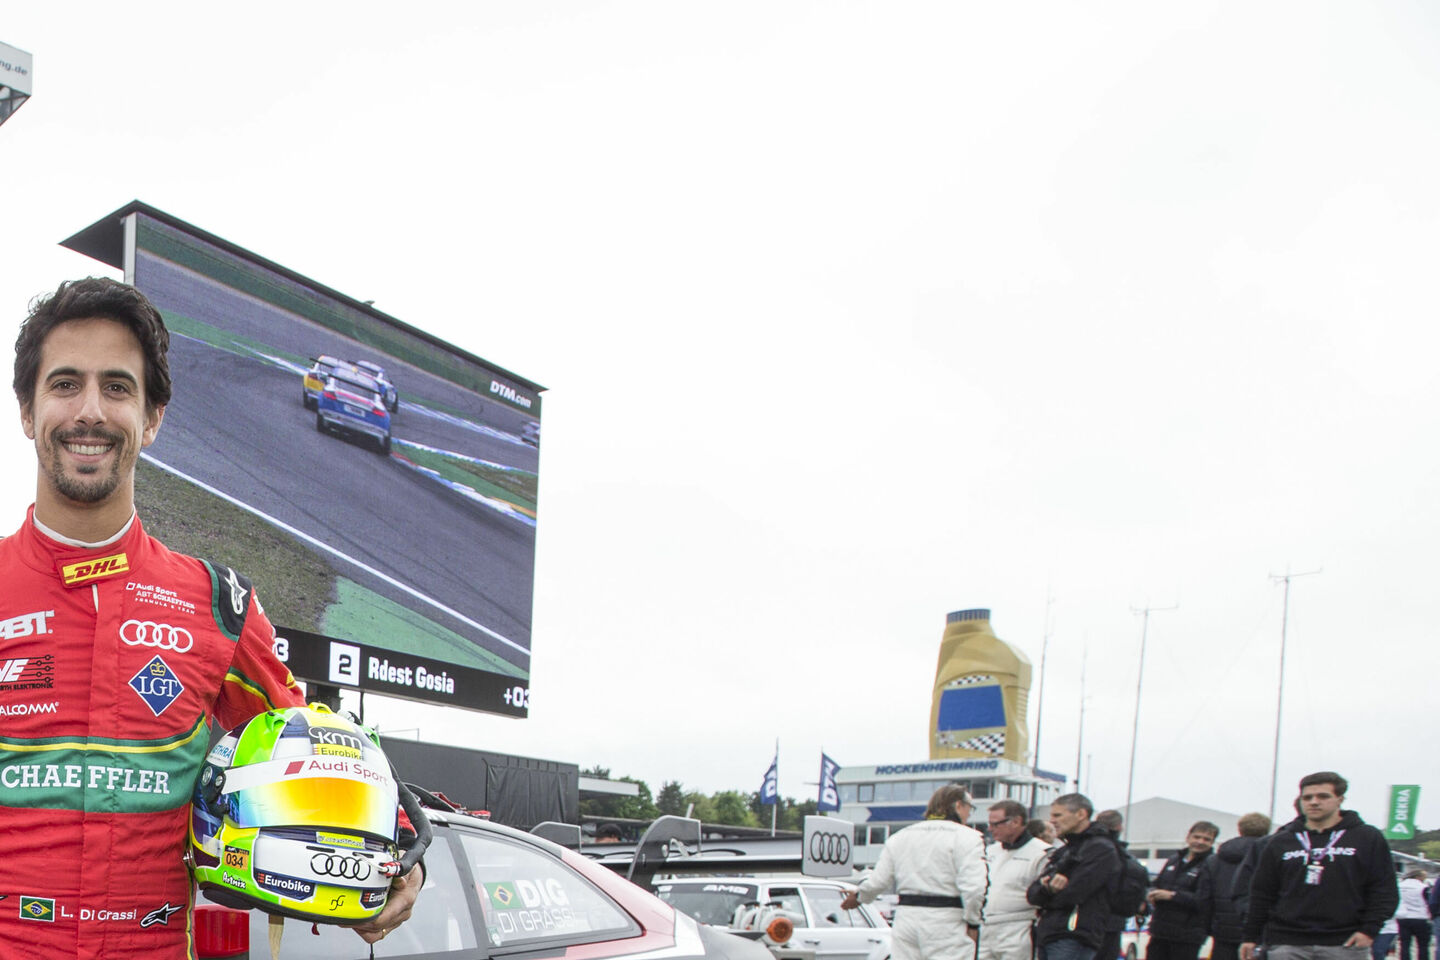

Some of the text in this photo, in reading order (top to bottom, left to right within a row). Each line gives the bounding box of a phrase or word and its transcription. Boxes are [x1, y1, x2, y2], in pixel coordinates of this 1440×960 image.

[490, 379, 531, 409] DTM.com
[74, 558, 121, 578] DHL
[136, 583, 178, 598] Audi Sport
[338, 653, 352, 675] 2
[368, 656, 412, 681] Rdest
[415, 666, 455, 694] Gosia
[137, 676, 178, 698] LGT
[308, 760, 389, 785] Audi Sport
[875, 759, 999, 776] HOCKENHEIMRING
[1394, 788, 1410, 821] DEKRA
[226, 852, 244, 869] 034
[264, 873, 312, 893] Eurobike
[515, 878, 571, 908] DIG
[61, 908, 74, 919] L.
[98, 909, 137, 921] Grassi
[498, 912, 519, 934] DI
